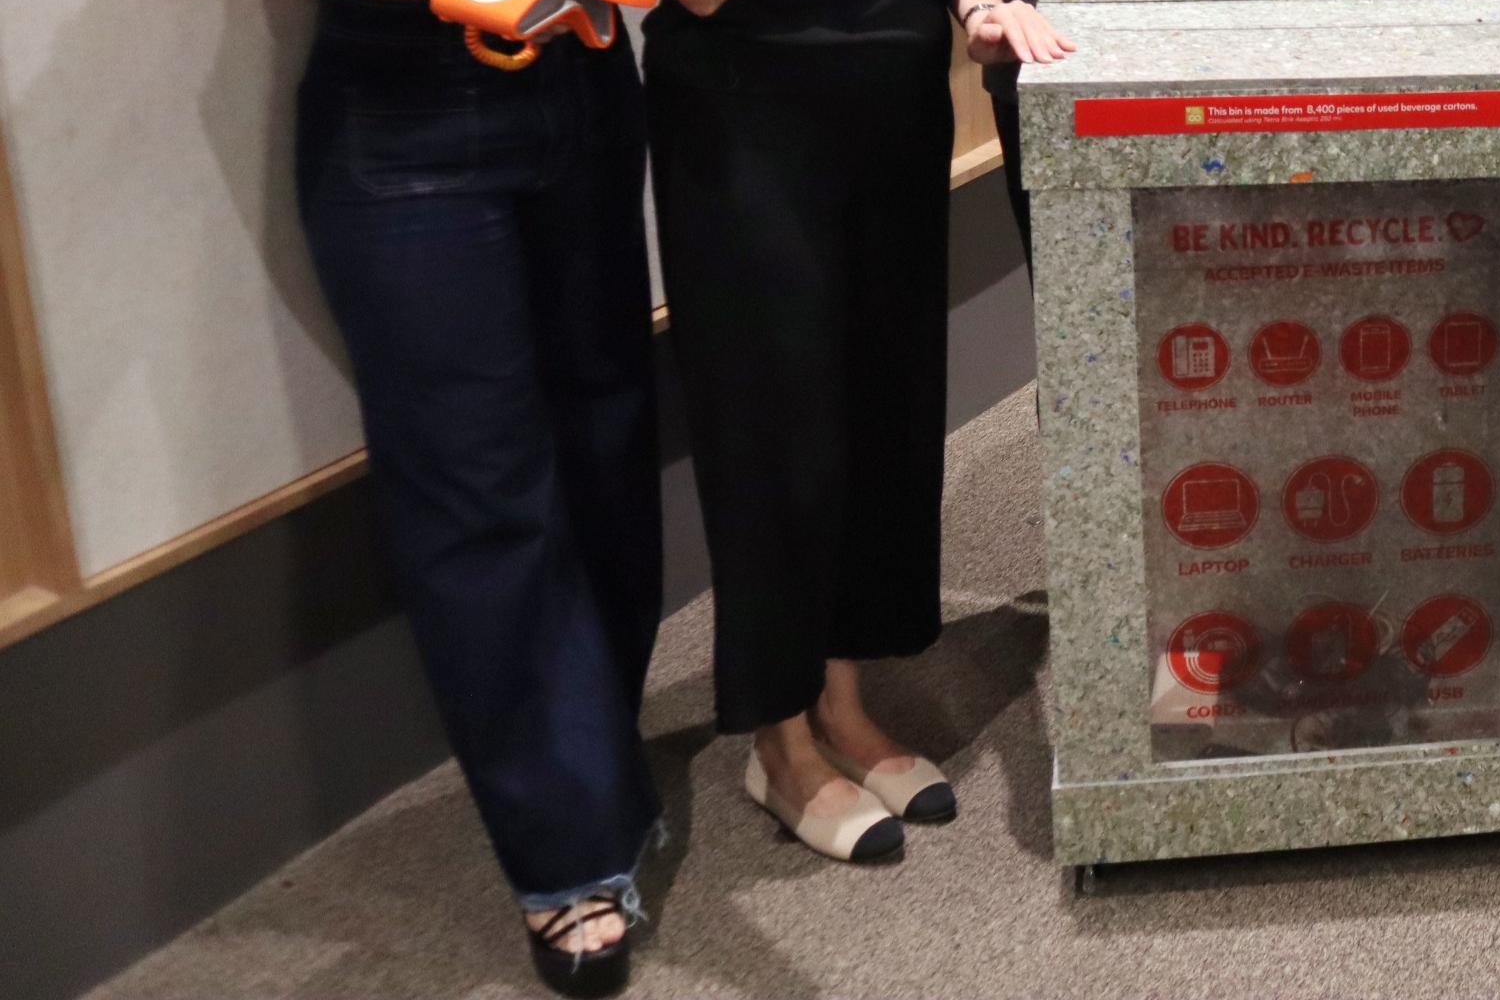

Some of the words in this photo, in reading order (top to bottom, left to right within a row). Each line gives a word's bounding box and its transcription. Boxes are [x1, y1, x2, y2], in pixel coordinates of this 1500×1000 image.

[1208, 106, 1227, 116] This
[1228, 106, 1242, 115] bin
[1245, 106, 1252, 115] is
[1254, 106, 1279, 115] made
[1281, 105, 1302, 115] from
[1336, 104, 1365, 114] pieces
[1366, 104, 1376, 113] of
[1378, 103, 1399, 113] used
[1400, 103, 1441, 114] beverage
[1443, 102, 1478, 111] cartons.
[1171, 224, 1209, 252] BE
[1203, 264, 1300, 282] ACCEPTED
[1303, 260, 1388, 278] E-WASTE
[1390, 258, 1445, 275] ITEMS
[1157, 397, 1237, 413] TELEPHONE
[1258, 393, 1313, 408] ROUTER
[1178, 558, 1250, 576] LAPTOP
[1288, 552, 1373, 570] CHARGER
[1428, 686, 1465, 701] USB
